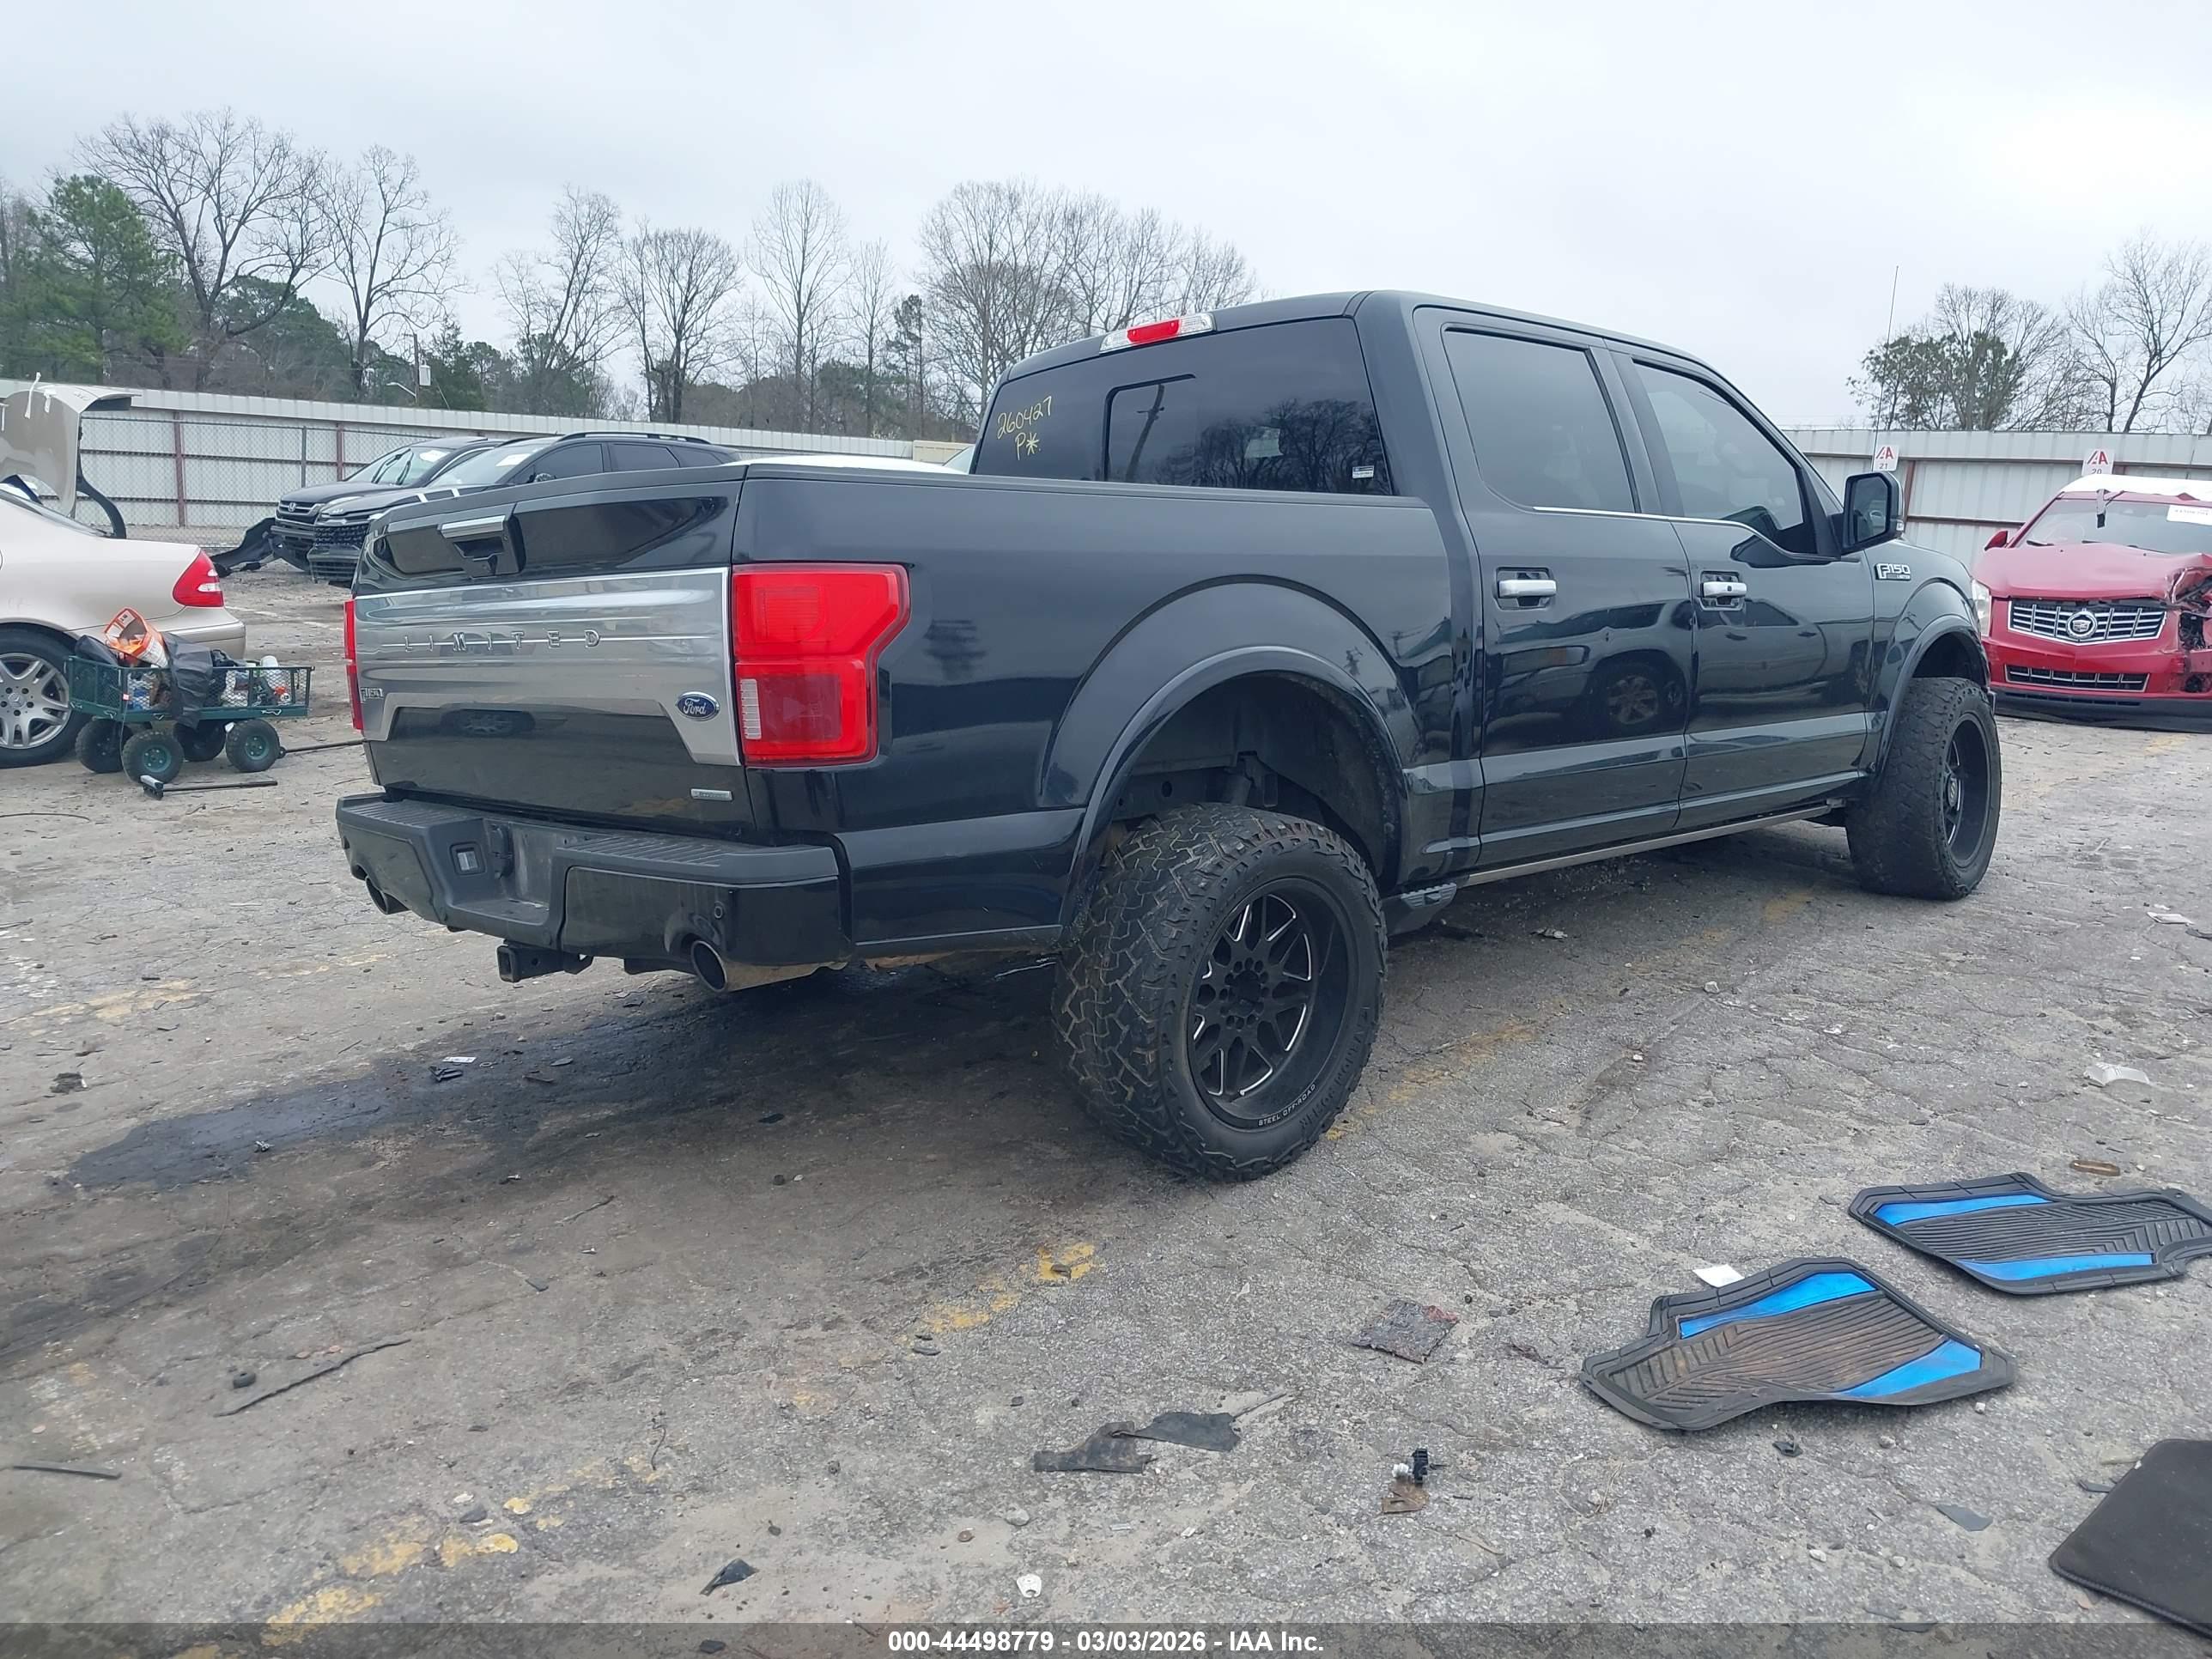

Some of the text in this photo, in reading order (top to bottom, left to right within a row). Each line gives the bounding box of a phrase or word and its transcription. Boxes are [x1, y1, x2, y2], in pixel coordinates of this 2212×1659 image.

[997, 395, 1052, 440] 260427
[404, 629, 600, 653] LIMITED
[683, 697, 707, 715] Ford
[1257, 1083, 1316, 1127] STEEL OFF-ROAD
